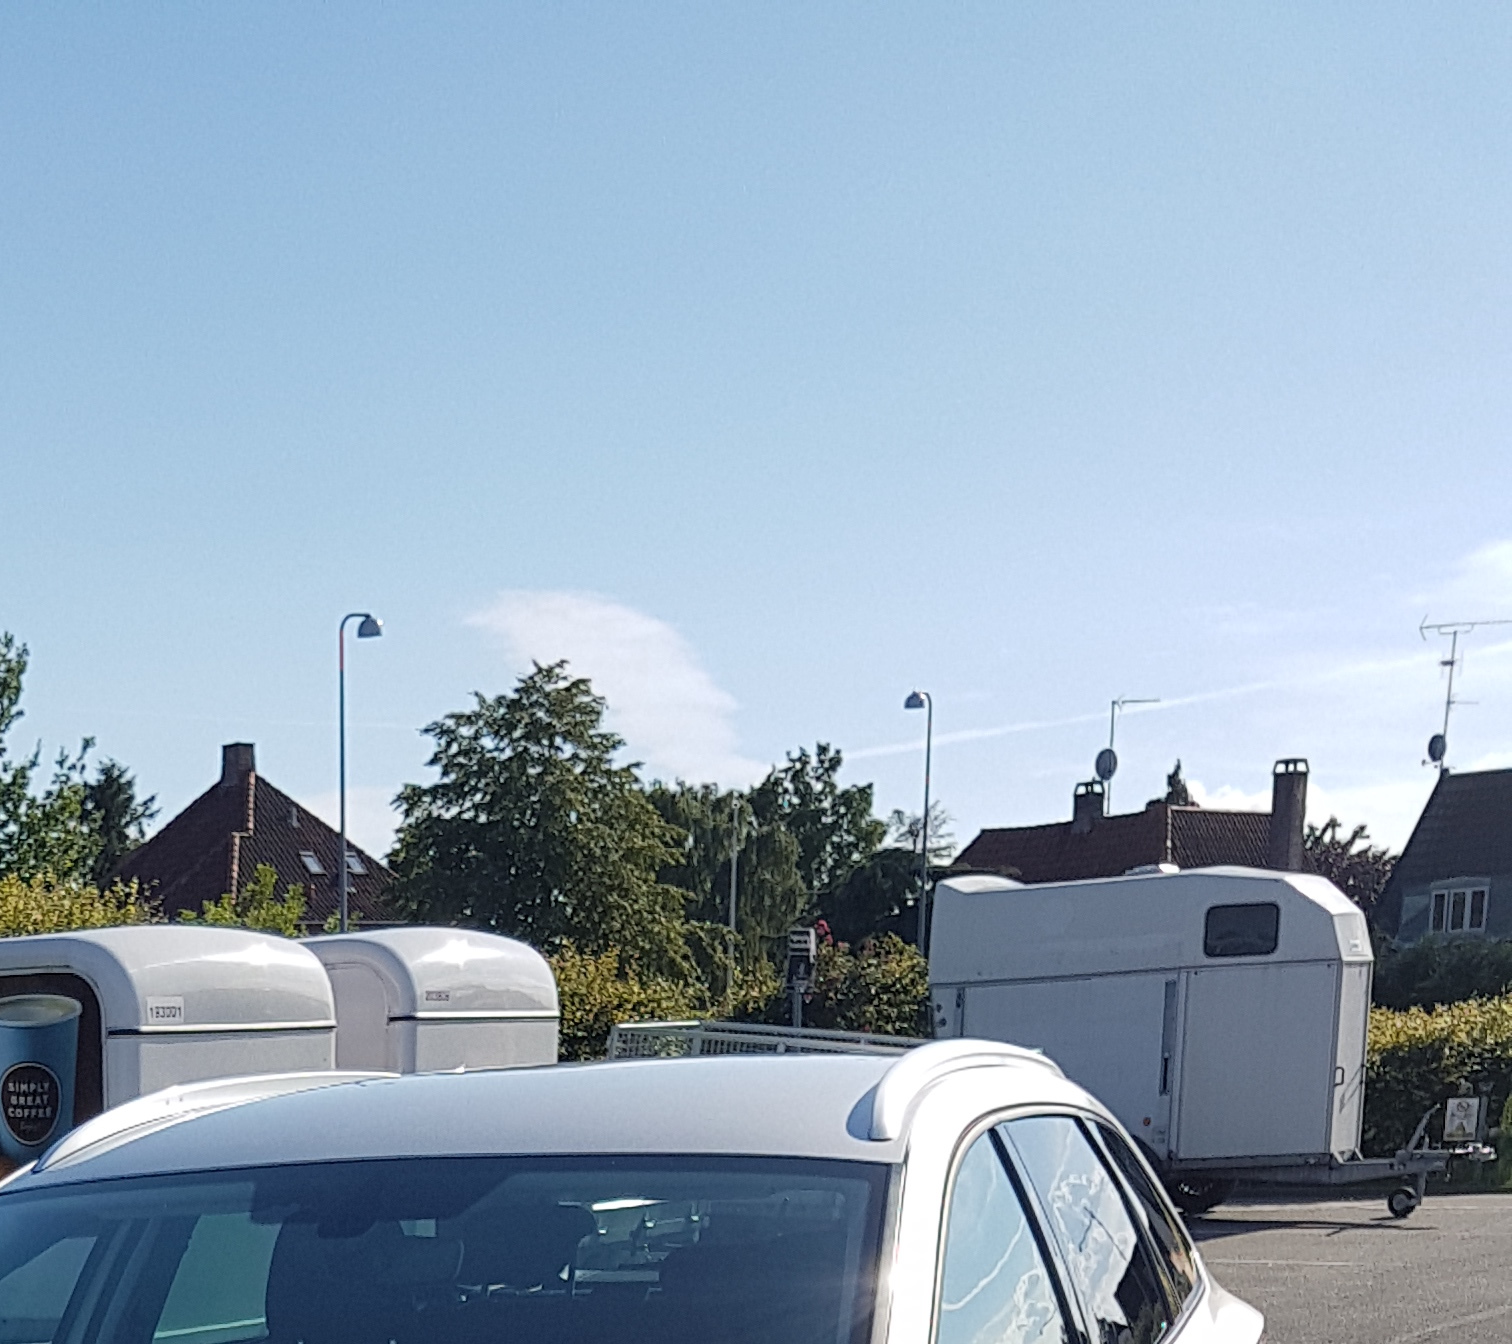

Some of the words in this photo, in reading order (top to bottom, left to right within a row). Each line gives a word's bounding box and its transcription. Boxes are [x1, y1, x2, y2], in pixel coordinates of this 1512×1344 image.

[7, 1082, 50, 1093] SIMPLY
[10, 1095, 49, 1106] GREAT
[7, 1107, 52, 1118] COFFEE
